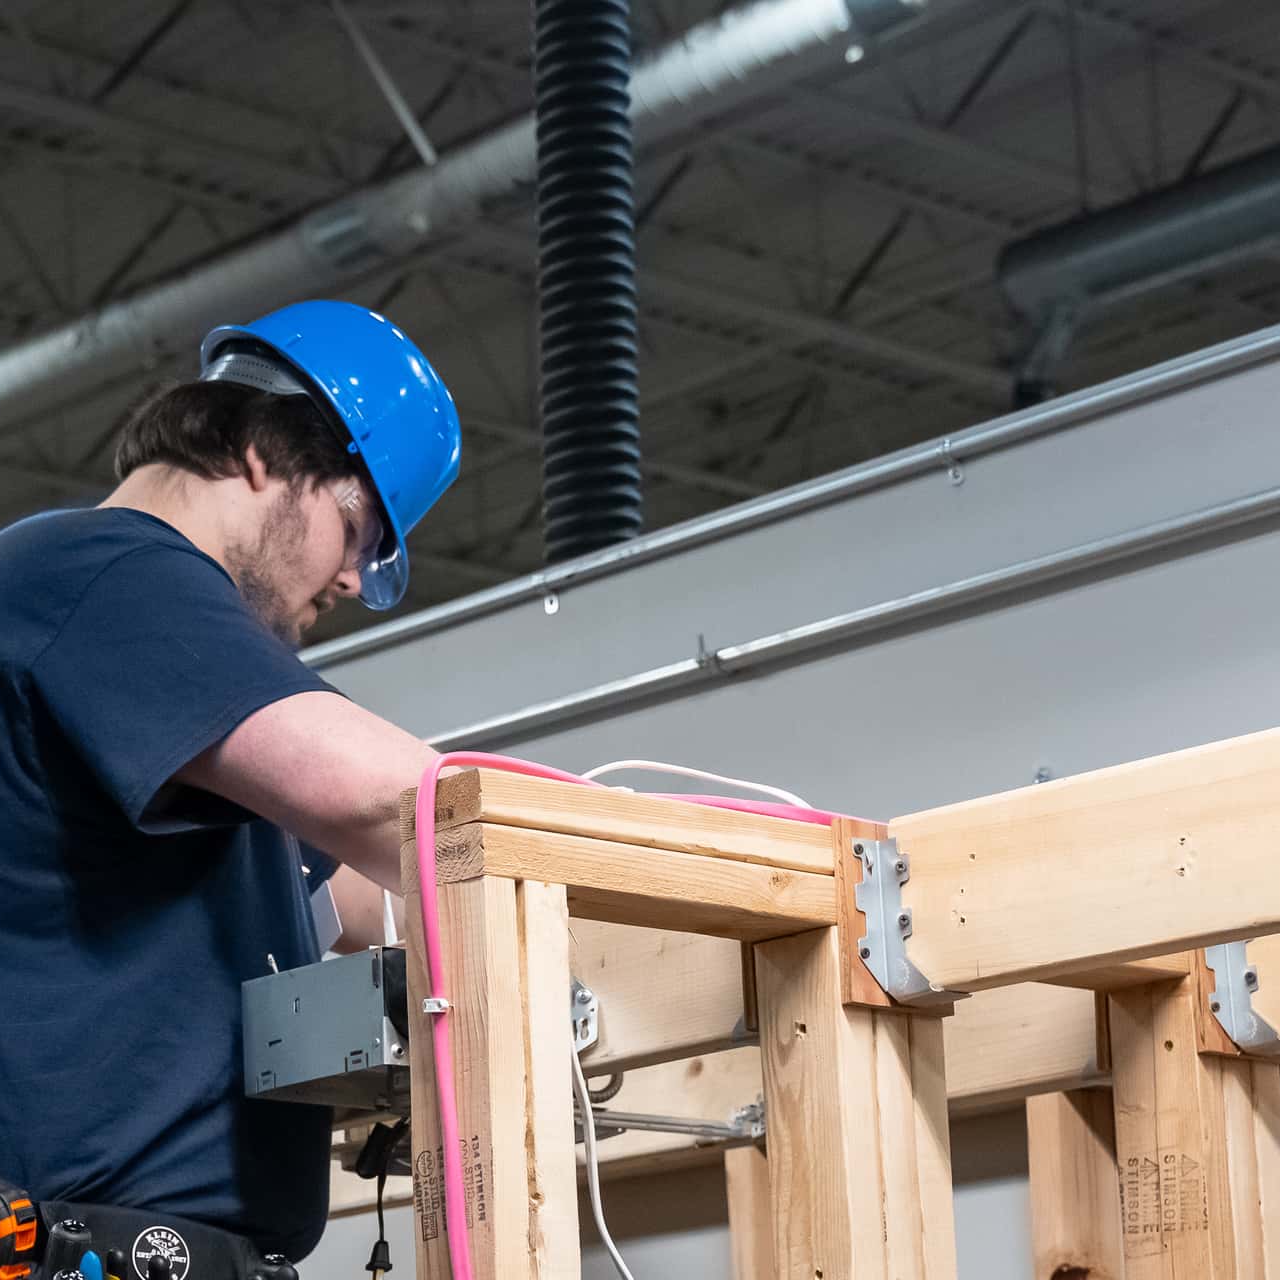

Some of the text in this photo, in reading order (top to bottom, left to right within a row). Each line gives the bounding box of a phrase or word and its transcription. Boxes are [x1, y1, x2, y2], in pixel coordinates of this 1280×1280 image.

[429, 1176, 439, 1209] STUD
[1127, 1157, 1140, 1235] STIMSON
[1163, 1154, 1177, 1232] STIMSON
[145, 1231, 180, 1246] KLEIN
